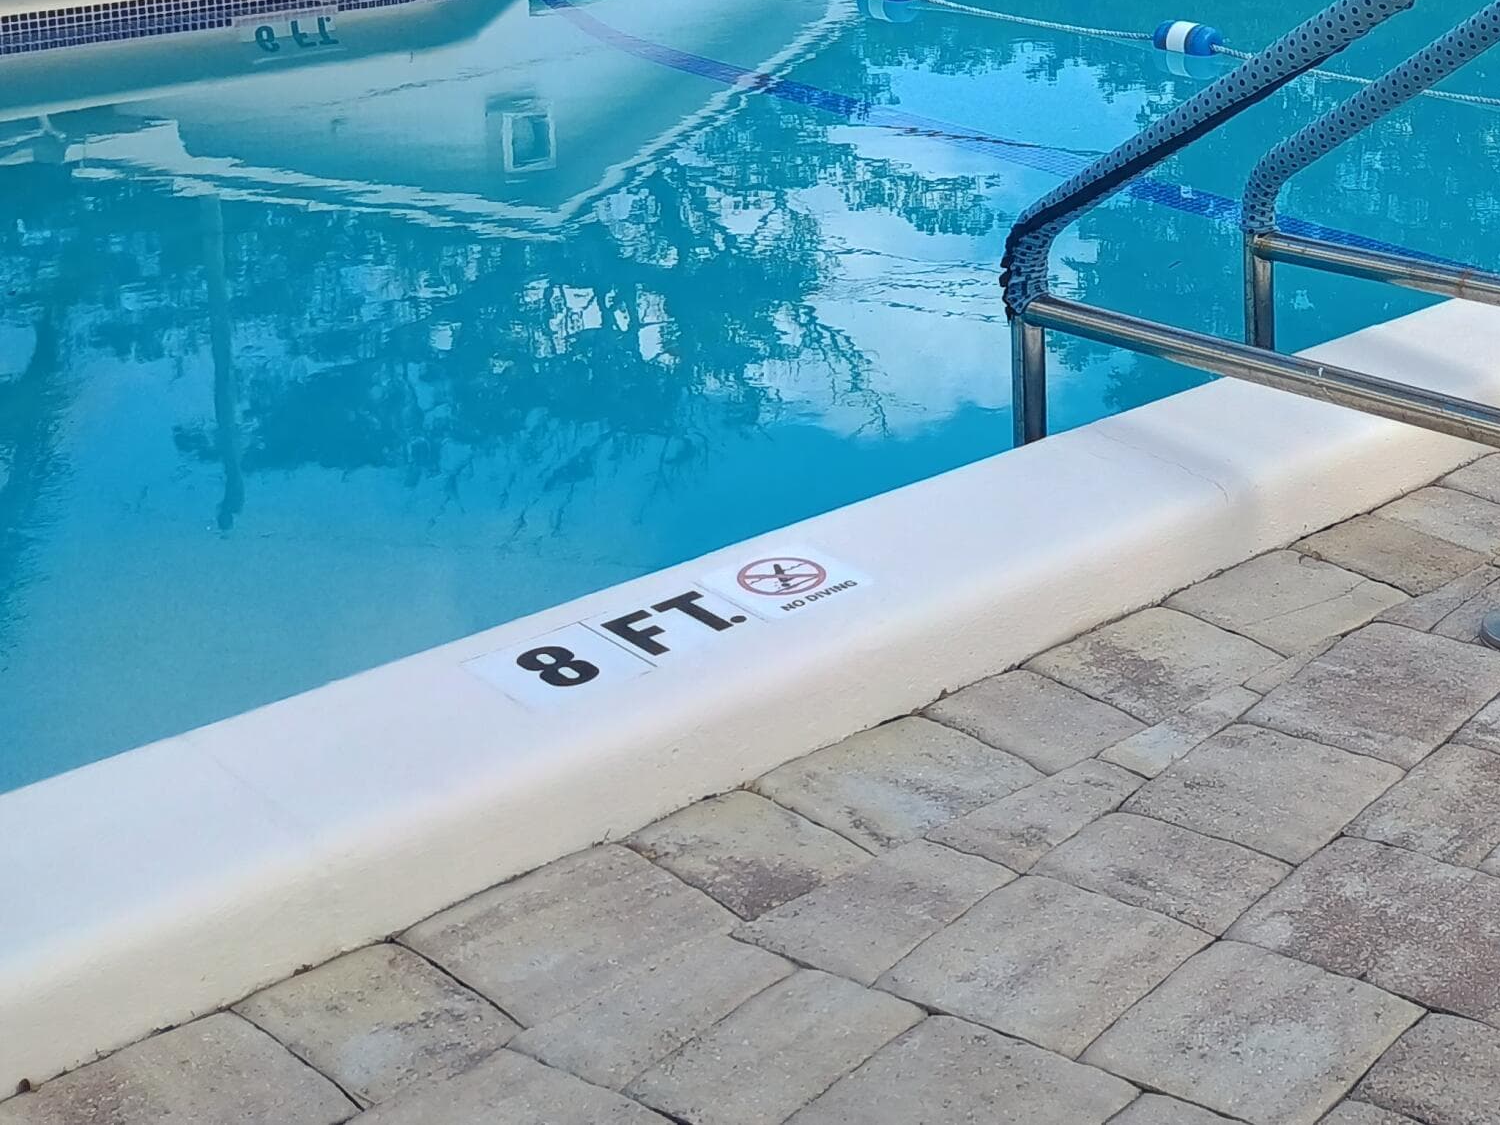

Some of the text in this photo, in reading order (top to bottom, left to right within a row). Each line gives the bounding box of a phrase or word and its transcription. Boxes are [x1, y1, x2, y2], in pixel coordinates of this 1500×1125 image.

[780, 579, 858, 611] NO DIVING
[516, 590, 748, 687] 8 FT.
